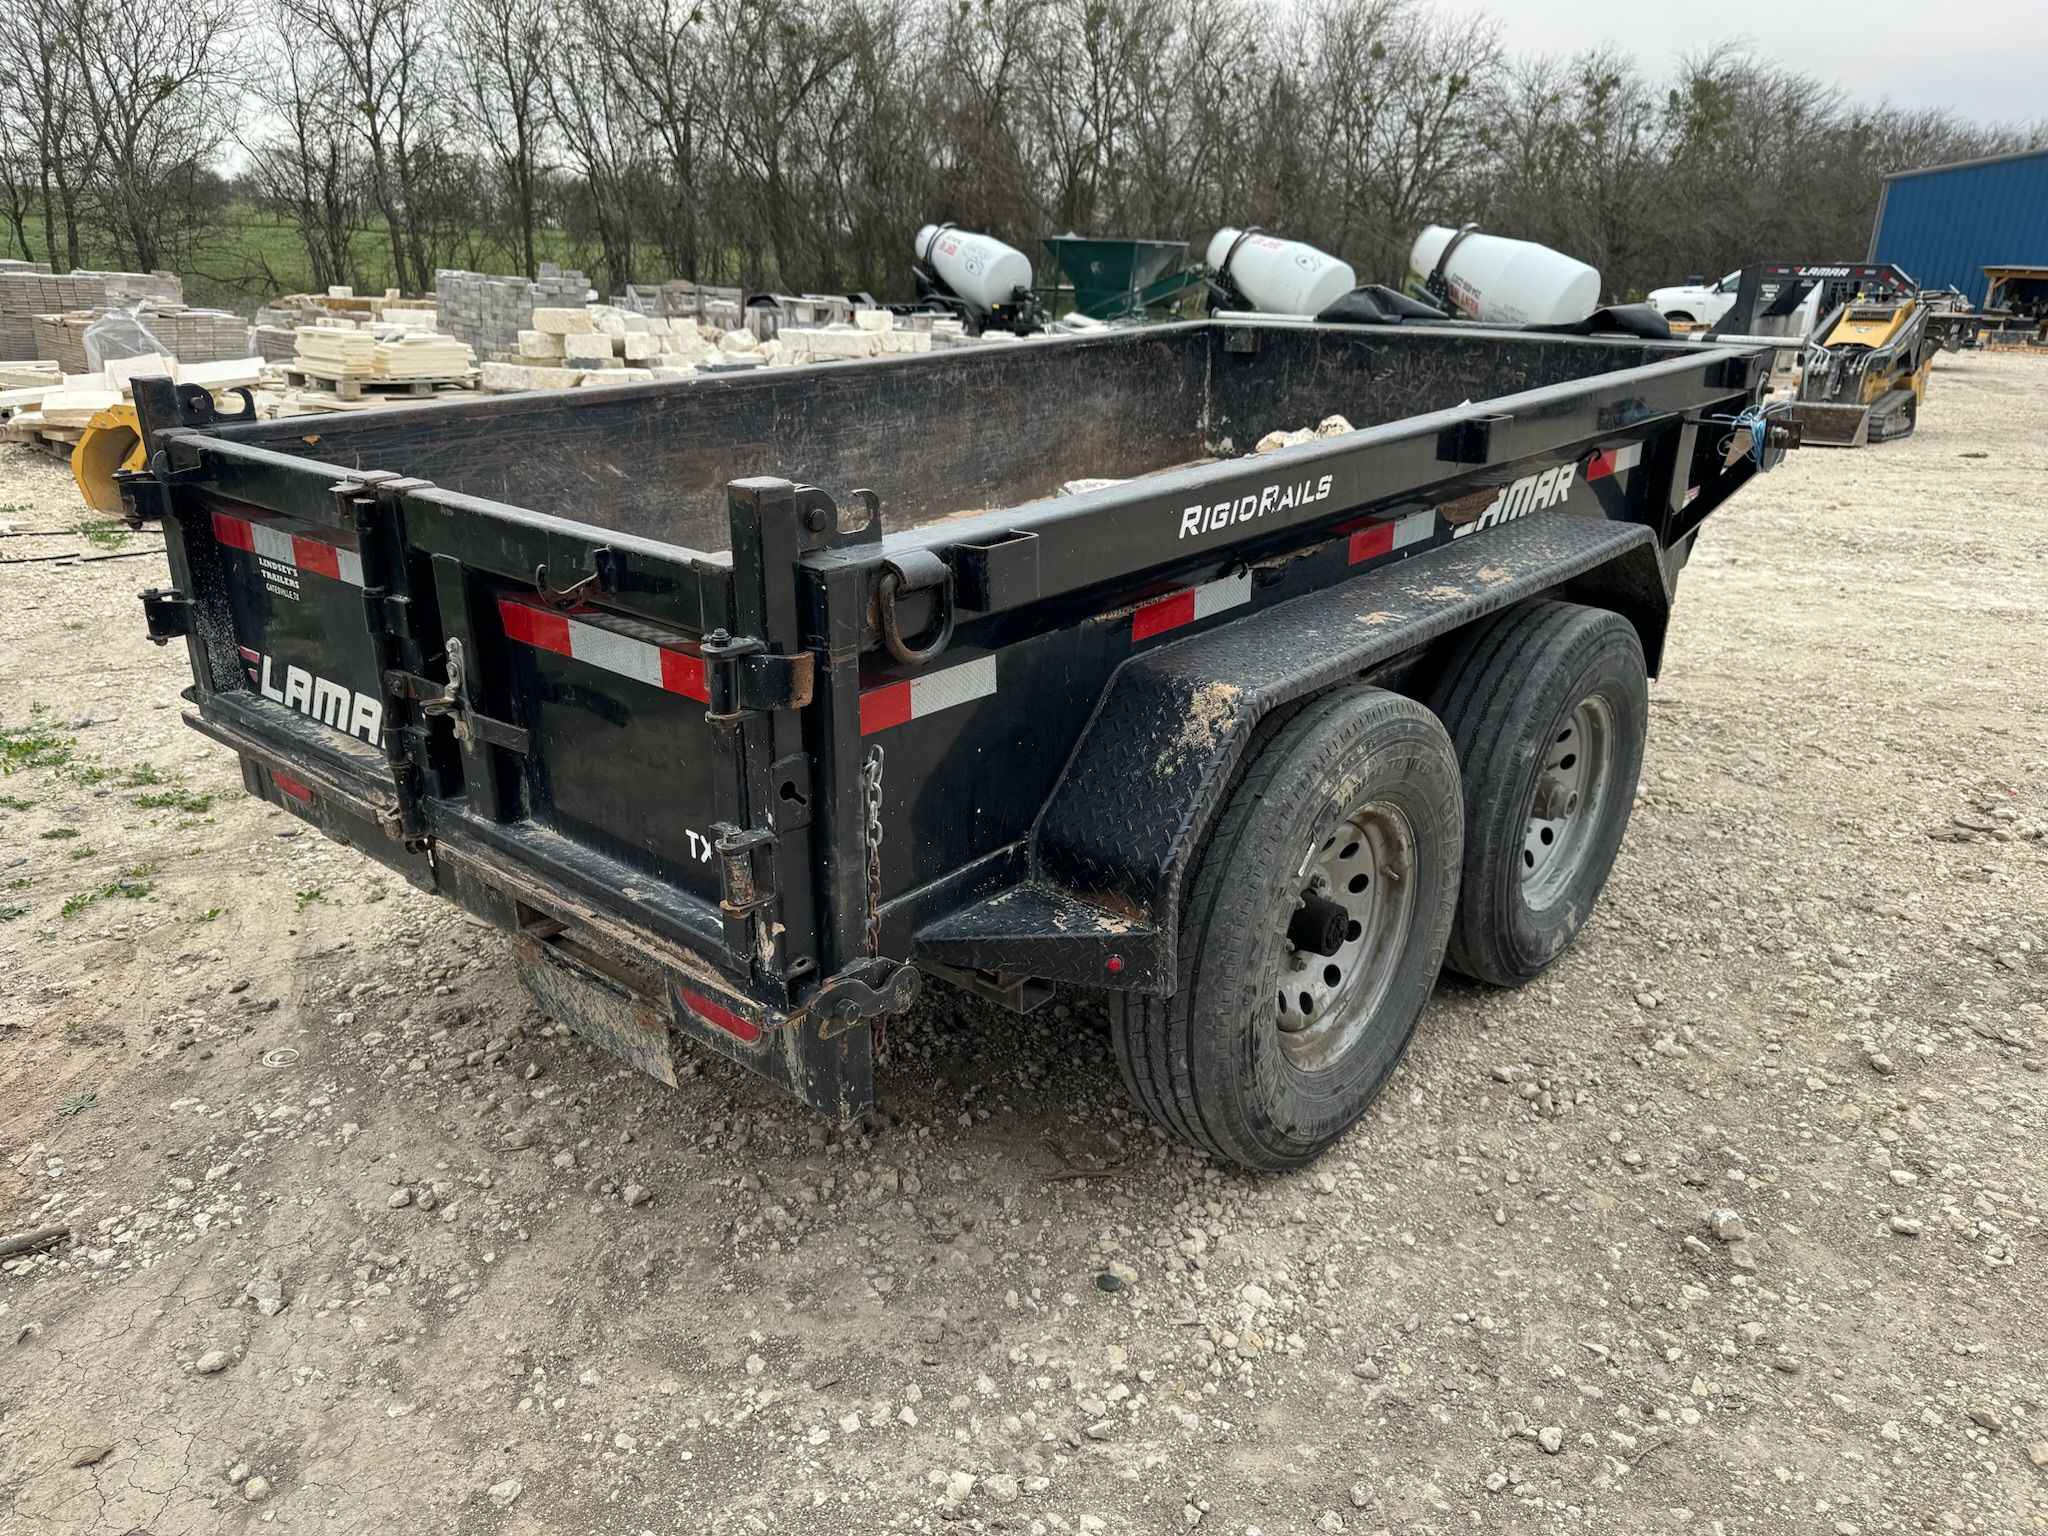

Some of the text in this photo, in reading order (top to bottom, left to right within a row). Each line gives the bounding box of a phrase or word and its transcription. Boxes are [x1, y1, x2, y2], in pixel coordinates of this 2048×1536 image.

[1798, 266, 1850, 277] LAMAR
[1450, 462, 1579, 539] AMAR
[258, 556, 299, 578] LINDSEY'S
[261, 568, 300, 590] TRAILERS
[260, 655, 386, 750] LAMA
